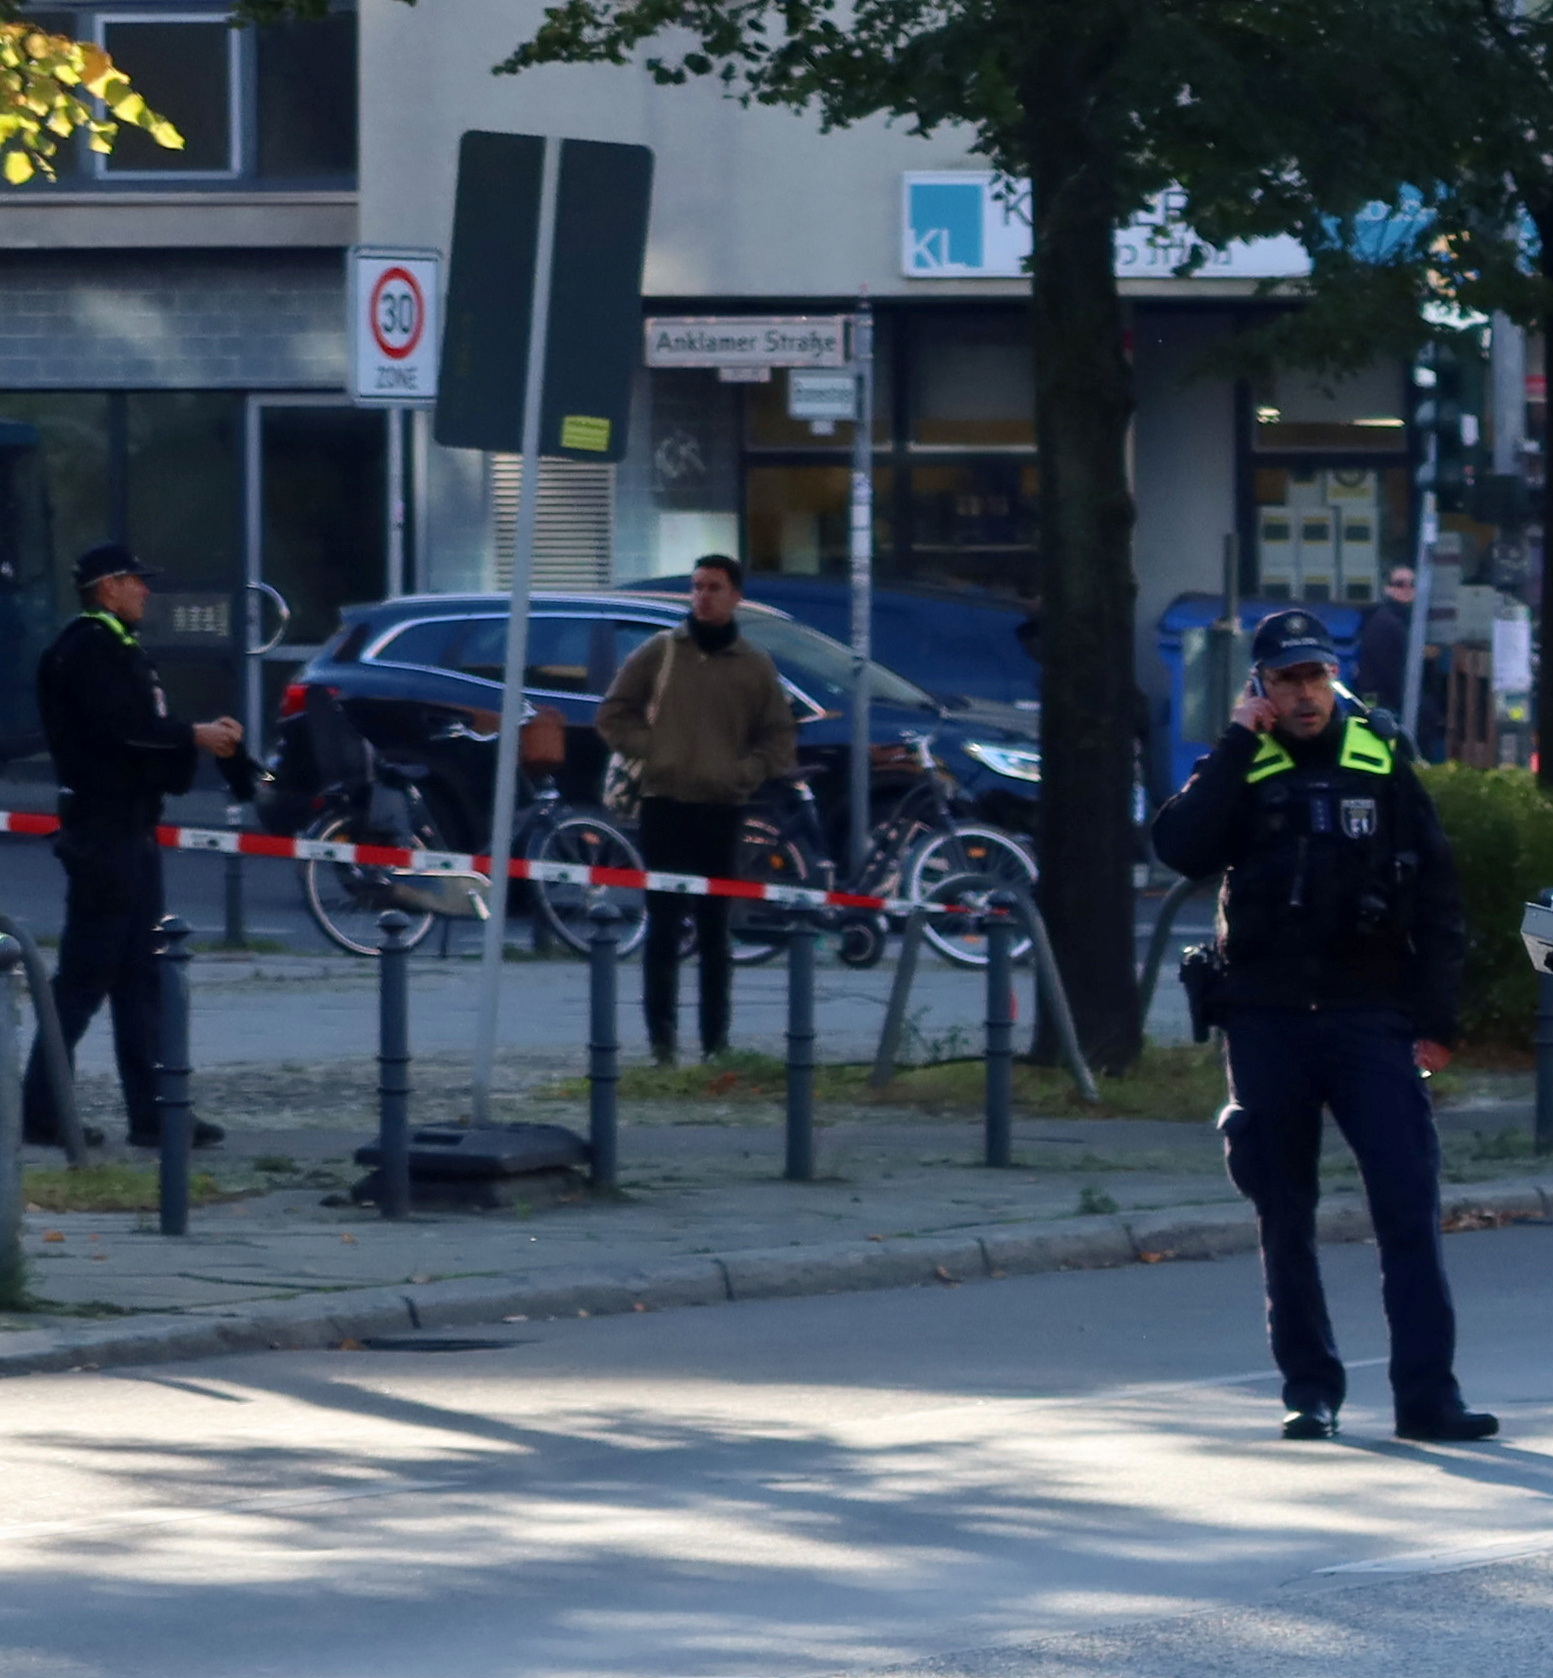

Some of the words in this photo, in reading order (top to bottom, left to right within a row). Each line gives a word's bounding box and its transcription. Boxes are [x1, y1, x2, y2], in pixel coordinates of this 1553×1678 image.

[908, 228, 967, 270] KL
[381, 293, 413, 334] 30
[656, 331, 757, 351] Anklamer
[764, 330, 837, 357] Straße
